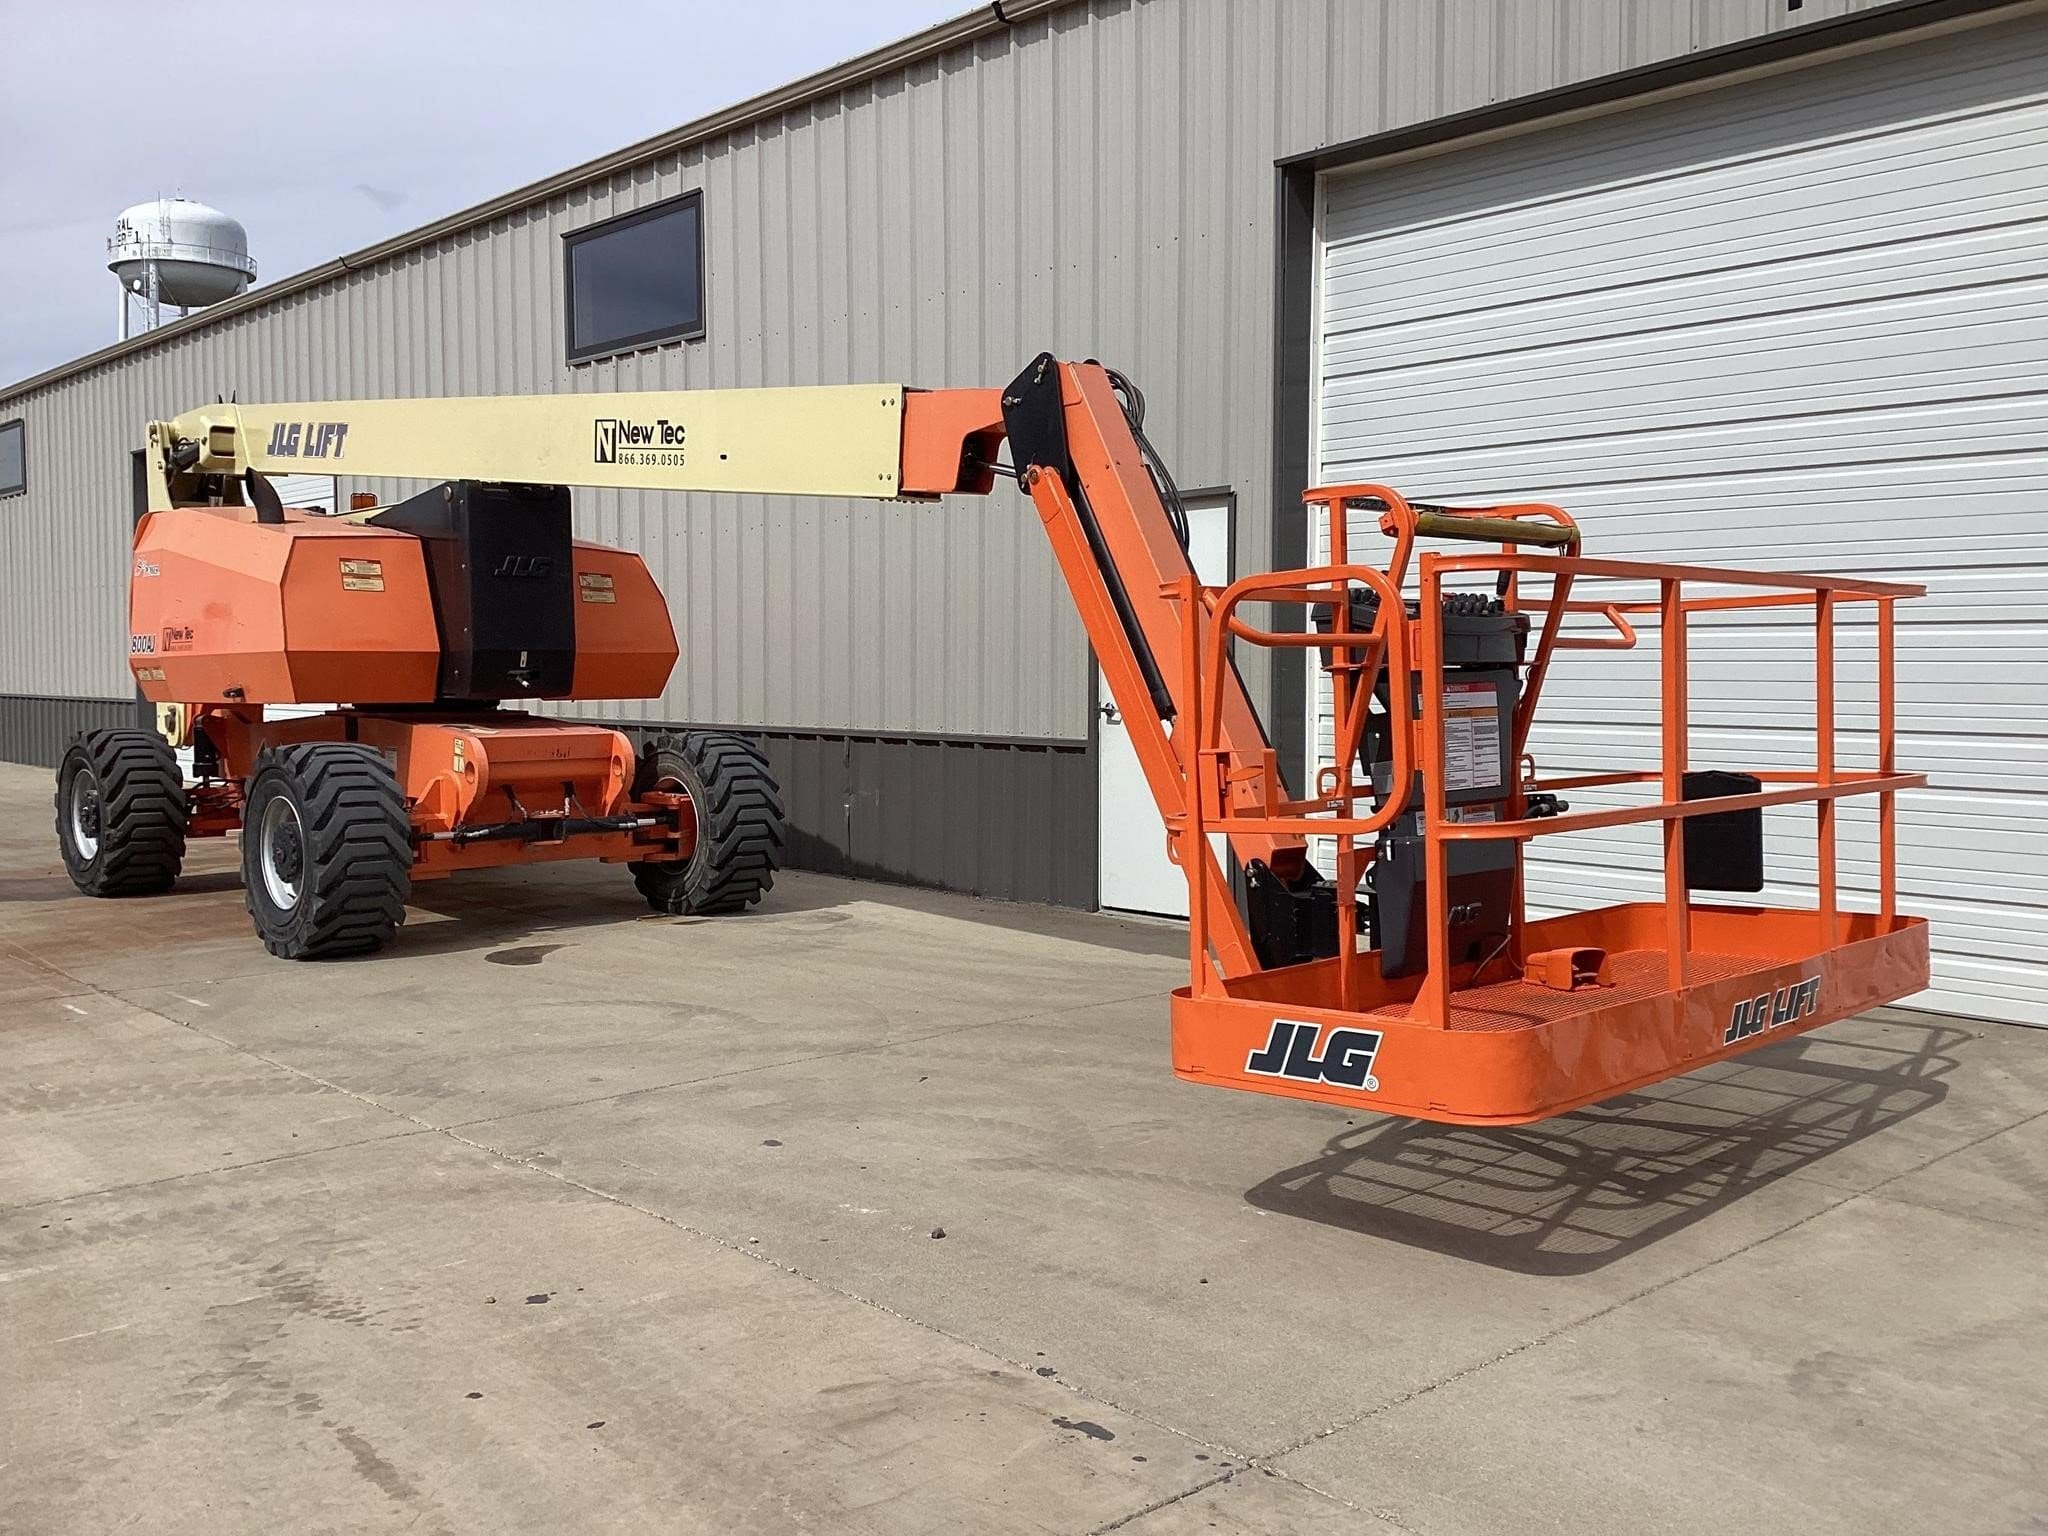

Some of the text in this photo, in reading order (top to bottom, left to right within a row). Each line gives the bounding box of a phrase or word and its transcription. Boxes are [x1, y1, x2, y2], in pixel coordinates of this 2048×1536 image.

[267, 422, 348, 459] JLG LIFT
[618, 420, 655, 444] New
[656, 420, 685, 444] Tec
[618, 453, 685, 466] 866.369.0505
[1722, 975, 1821, 1046] JLG LIFT
[1245, 1018, 1384, 1091] JLG
